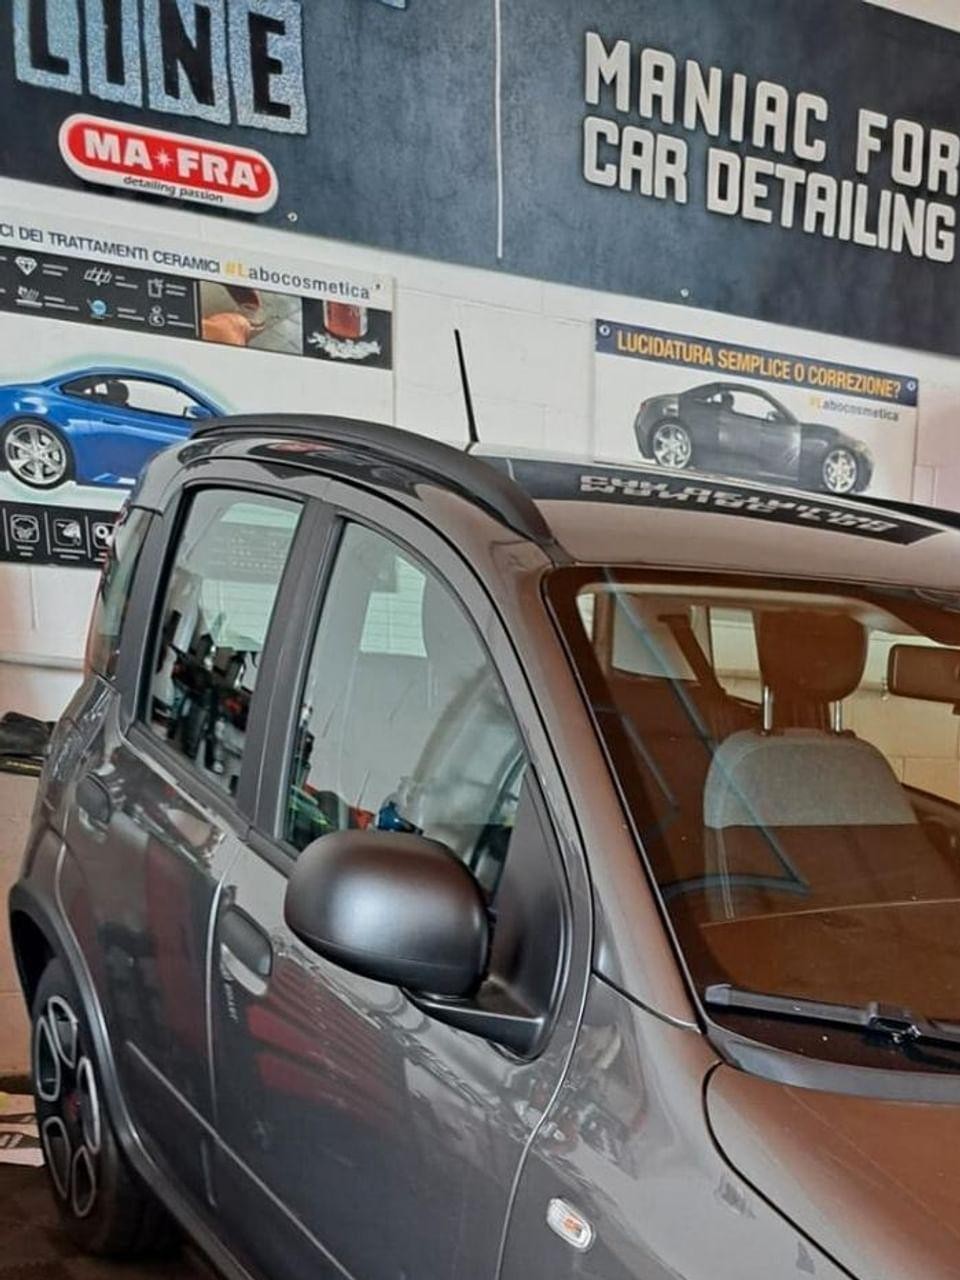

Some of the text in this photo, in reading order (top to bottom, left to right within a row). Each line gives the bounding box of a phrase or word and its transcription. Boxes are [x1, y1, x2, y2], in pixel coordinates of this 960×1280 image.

[584, 31, 960, 197] MANIAC FOR
[122, 176, 224, 204] detailing passion
[583, 115, 956, 263] CAR DETAILING
[18, 227, 43, 243] DEI
[47, 232, 149, 261] TRATTAMENTI
[152, 250, 221, 274] CERAMICI
[617, 330, 901, 399] LUCIDATURA SEMPLICE O CORREZIONE?
